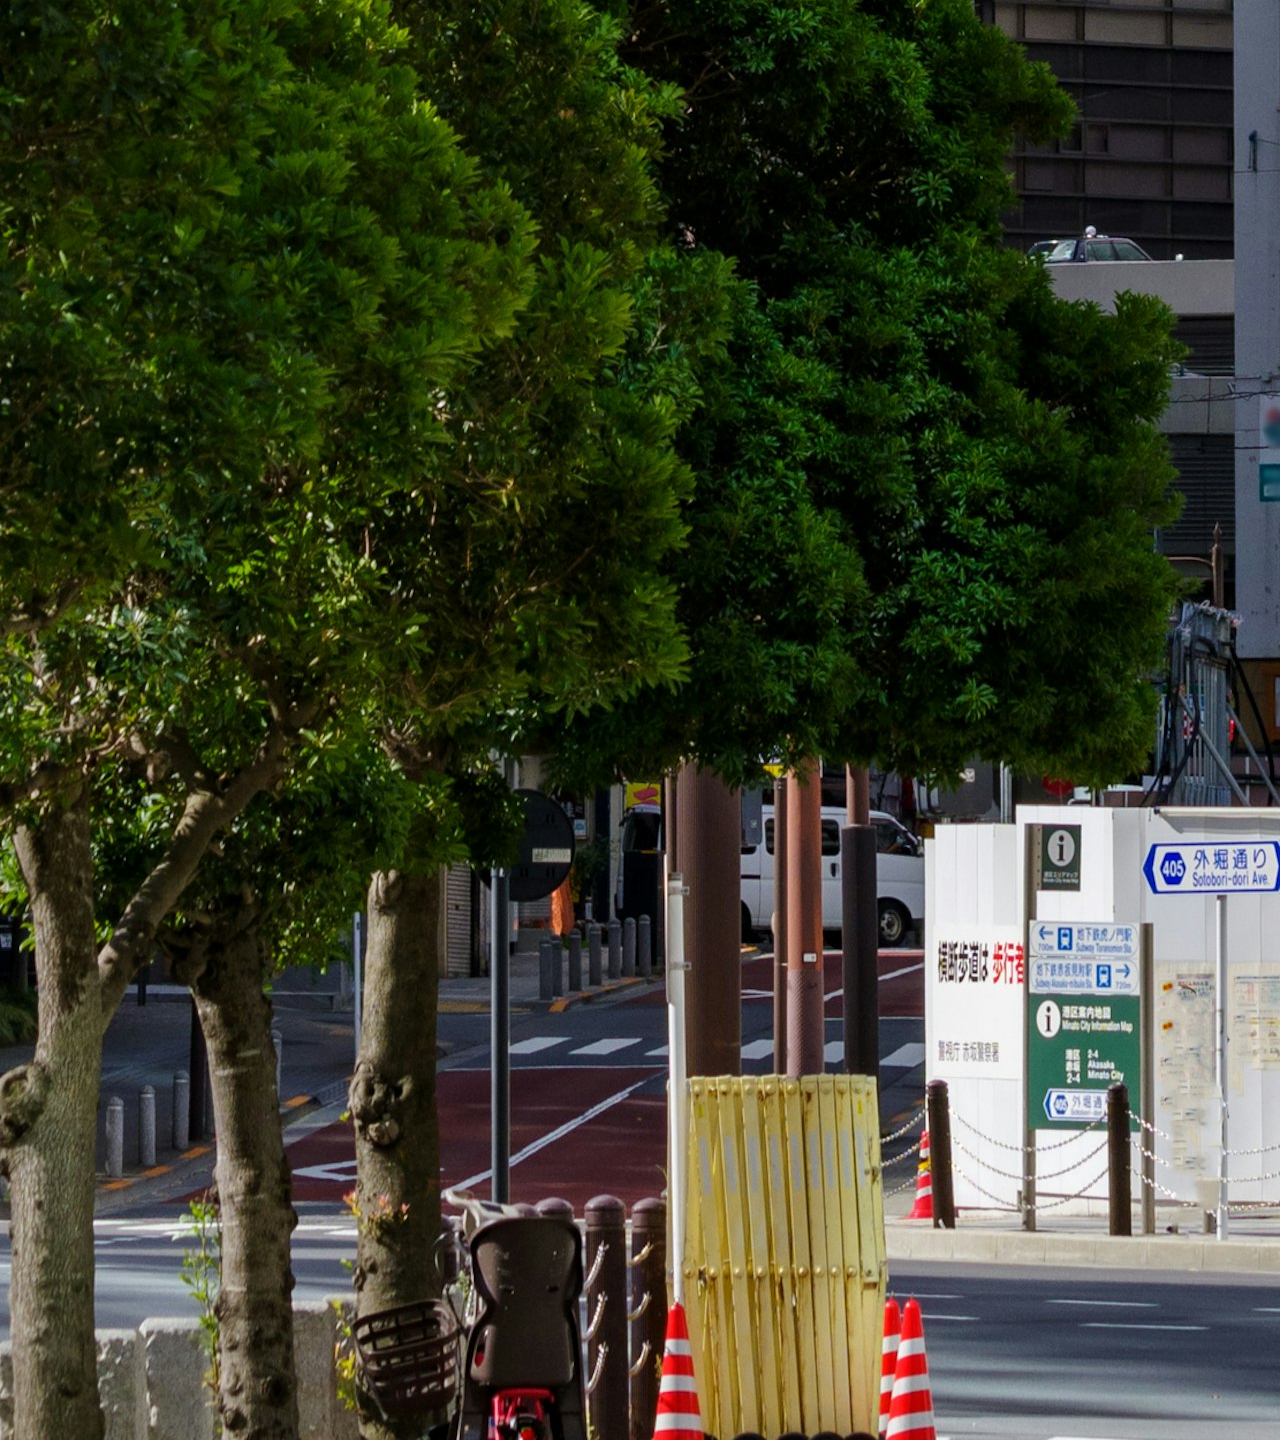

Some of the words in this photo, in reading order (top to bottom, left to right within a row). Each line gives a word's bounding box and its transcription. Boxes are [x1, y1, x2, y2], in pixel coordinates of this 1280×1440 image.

[1193, 848, 1267, 870] 外堀通り
[1162, 860, 1184, 878] 405
[1192, 872, 1249, 887] Sotobori-dori
[1252, 871, 1270, 885] Ave.
[938, 941, 989, 984] 横断歩道は
[1087, 1060, 1115, 1069] Akasaka
[1066, 1072, 1081, 1084] 2-4
[1087, 1070, 1109, 1079] Minato
[1110, 1070, 1125, 1082] City
[1072, 1095, 1108, 1109] 外堀通
